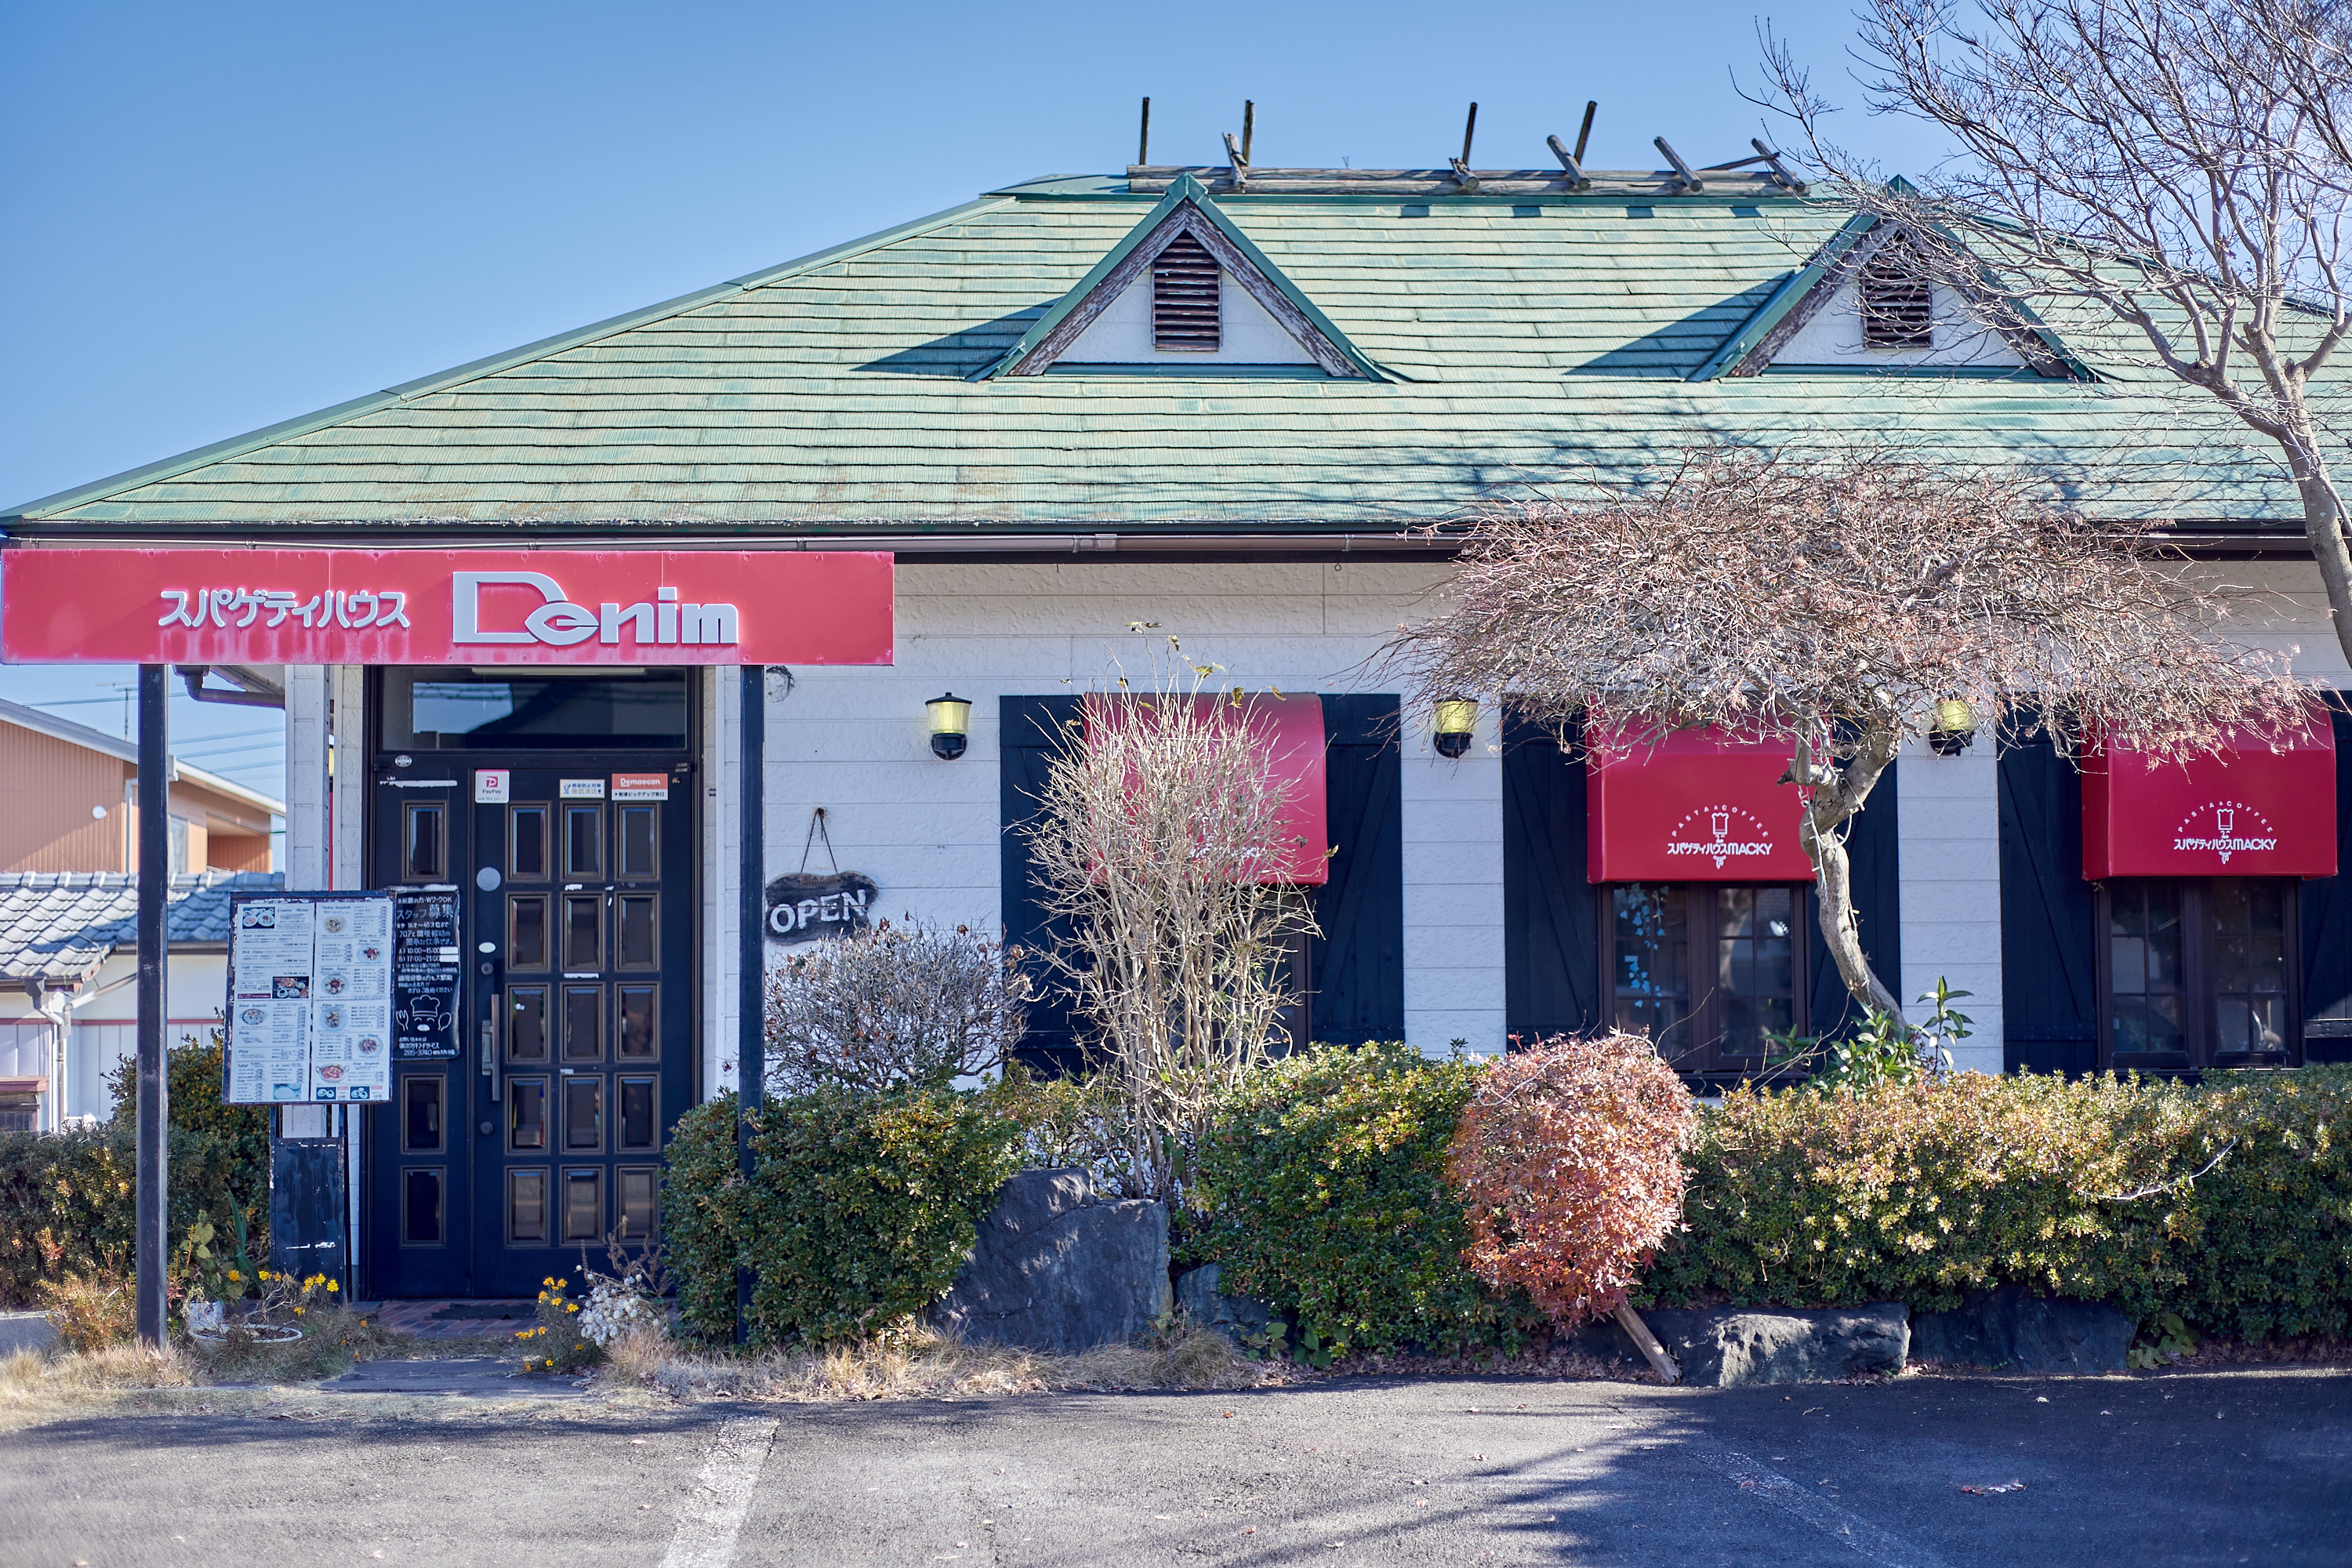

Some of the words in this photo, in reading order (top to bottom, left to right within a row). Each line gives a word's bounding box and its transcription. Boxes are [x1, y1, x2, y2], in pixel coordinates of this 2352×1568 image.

[158, 588, 411, 628] スパゲティハウス
[452, 571, 739, 646] Denim
[620, 778, 660, 786] Demaecan
[1671, 806, 1709, 837] PASTA
[1721, 804, 1769, 838] COFFEE
[2177, 802, 2215, 833] PASTA
[2226, 800, 2274, 833] COFFEE
[770, 889, 866, 933] OPEN
